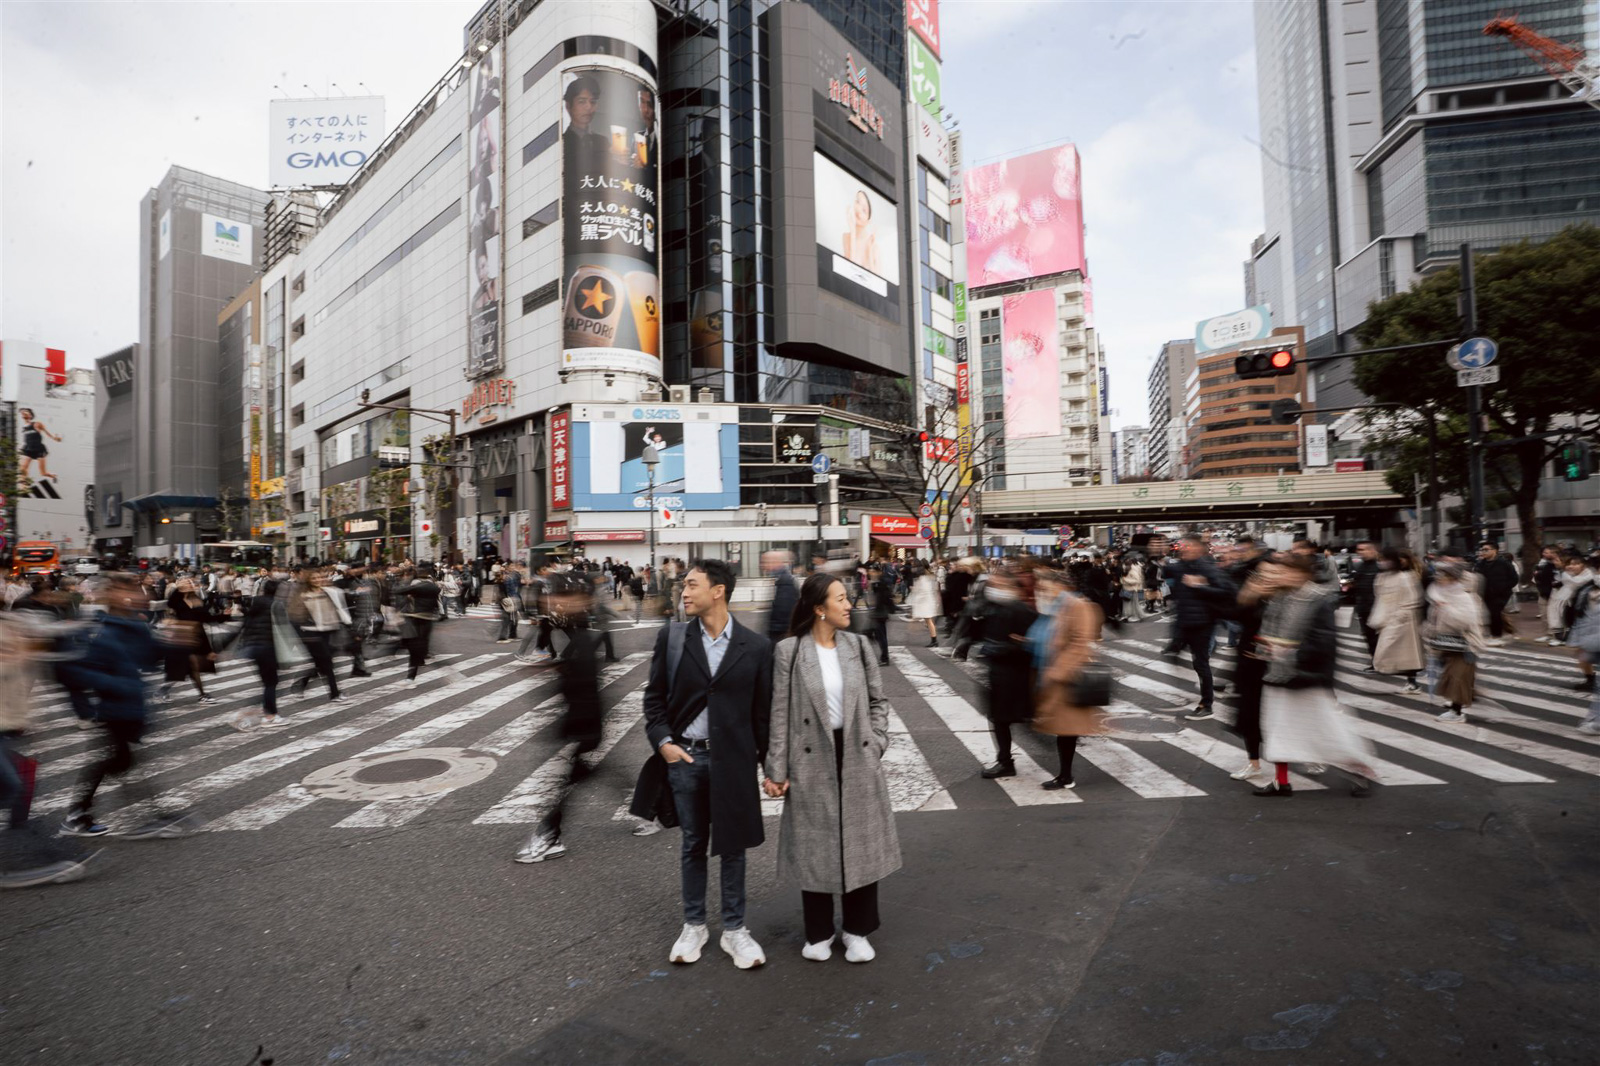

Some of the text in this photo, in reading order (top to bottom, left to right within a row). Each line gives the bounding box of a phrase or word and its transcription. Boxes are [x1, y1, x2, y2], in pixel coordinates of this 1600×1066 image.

[829, 78, 884, 141] MAGNET
[286, 114, 367, 129] すべての人に
[287, 130, 367, 144] インターネット
[287, 150, 367, 169] GMO
[580, 223, 643, 246] 黒ラベル
[462, 379, 513, 421] MAGNET
